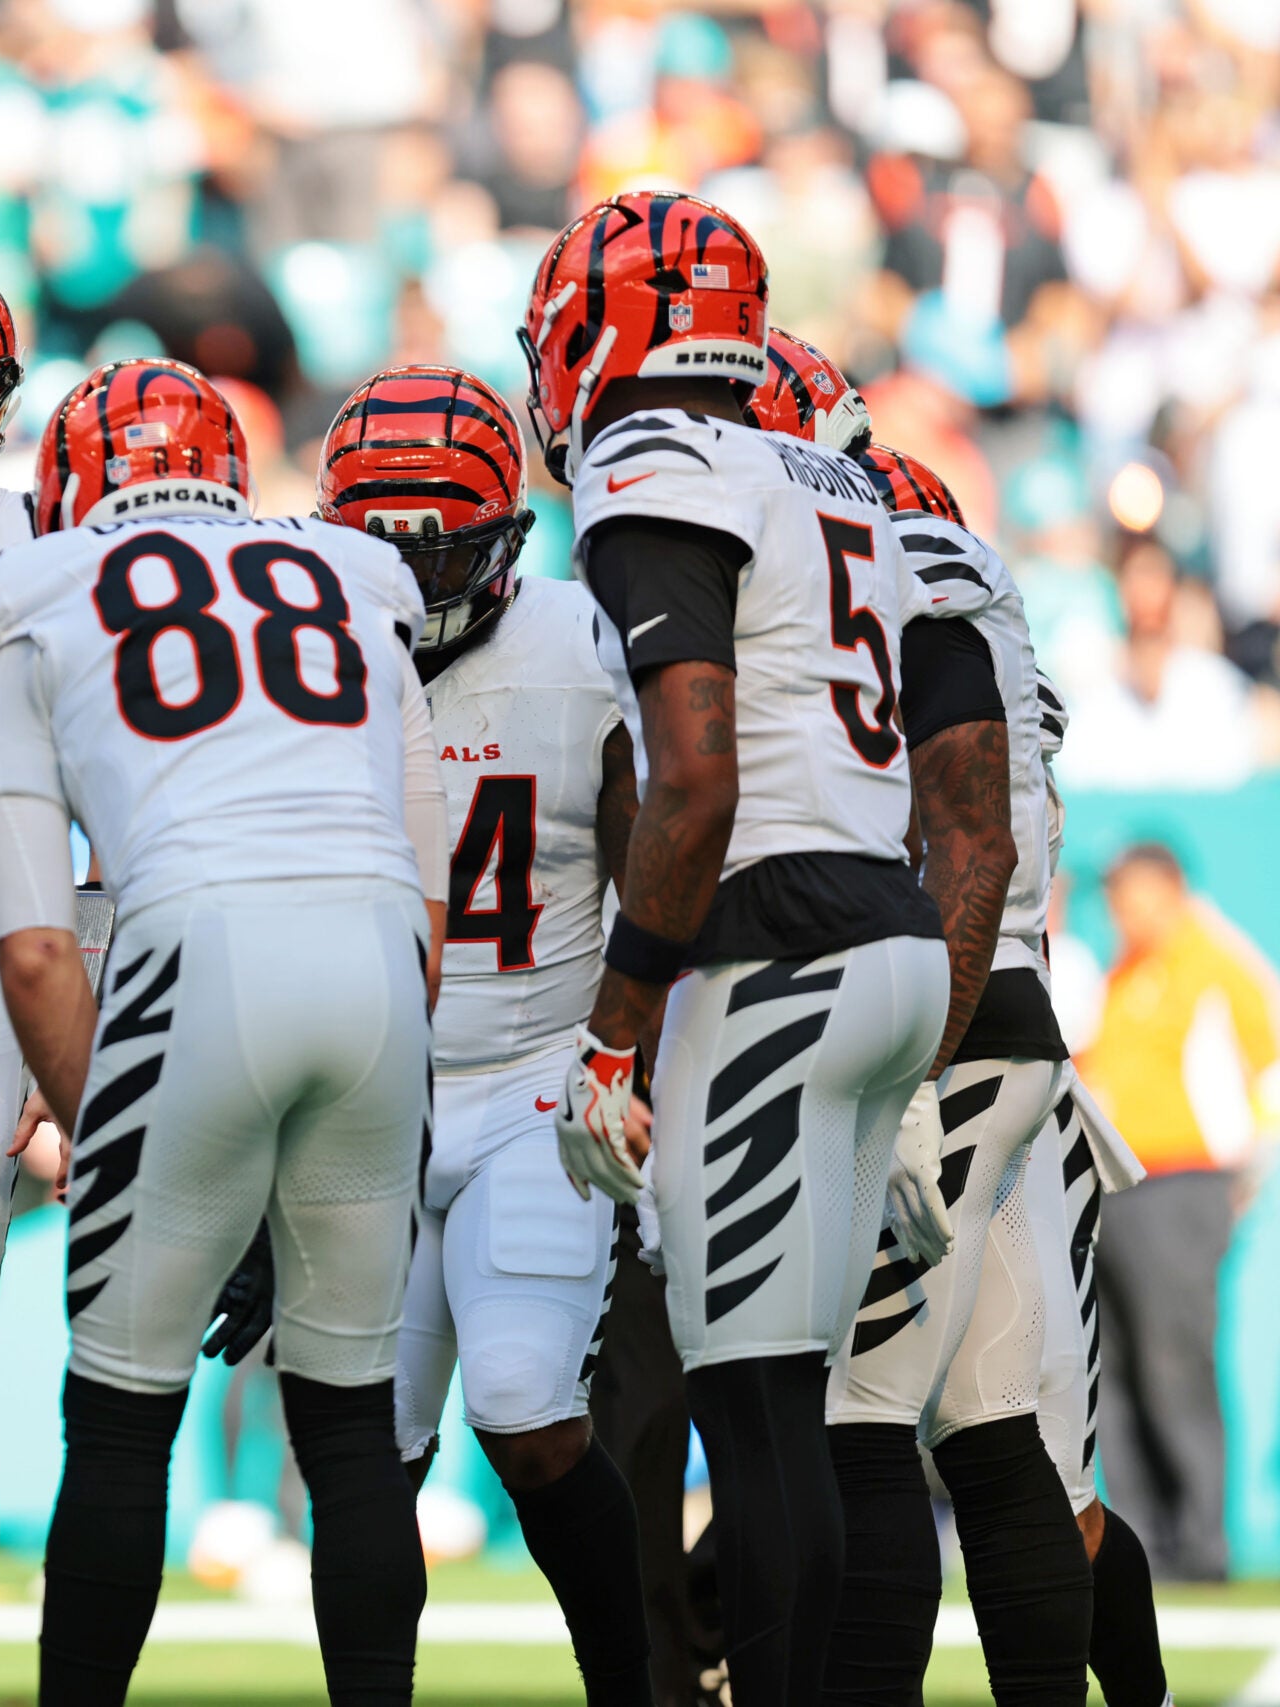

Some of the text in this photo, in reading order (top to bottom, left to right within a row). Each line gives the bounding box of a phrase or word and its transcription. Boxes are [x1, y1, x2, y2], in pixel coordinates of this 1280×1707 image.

[739, 302, 750, 335] 5
[676, 351, 764, 371] BENGALS
[153, 446, 203, 477] 88
[764, 436, 878, 506] HIGGINS
[114, 488, 237, 515] BENGALS
[91, 530, 369, 743] 88
[816, 509, 901, 769] 5
[445, 774, 546, 972] 4
